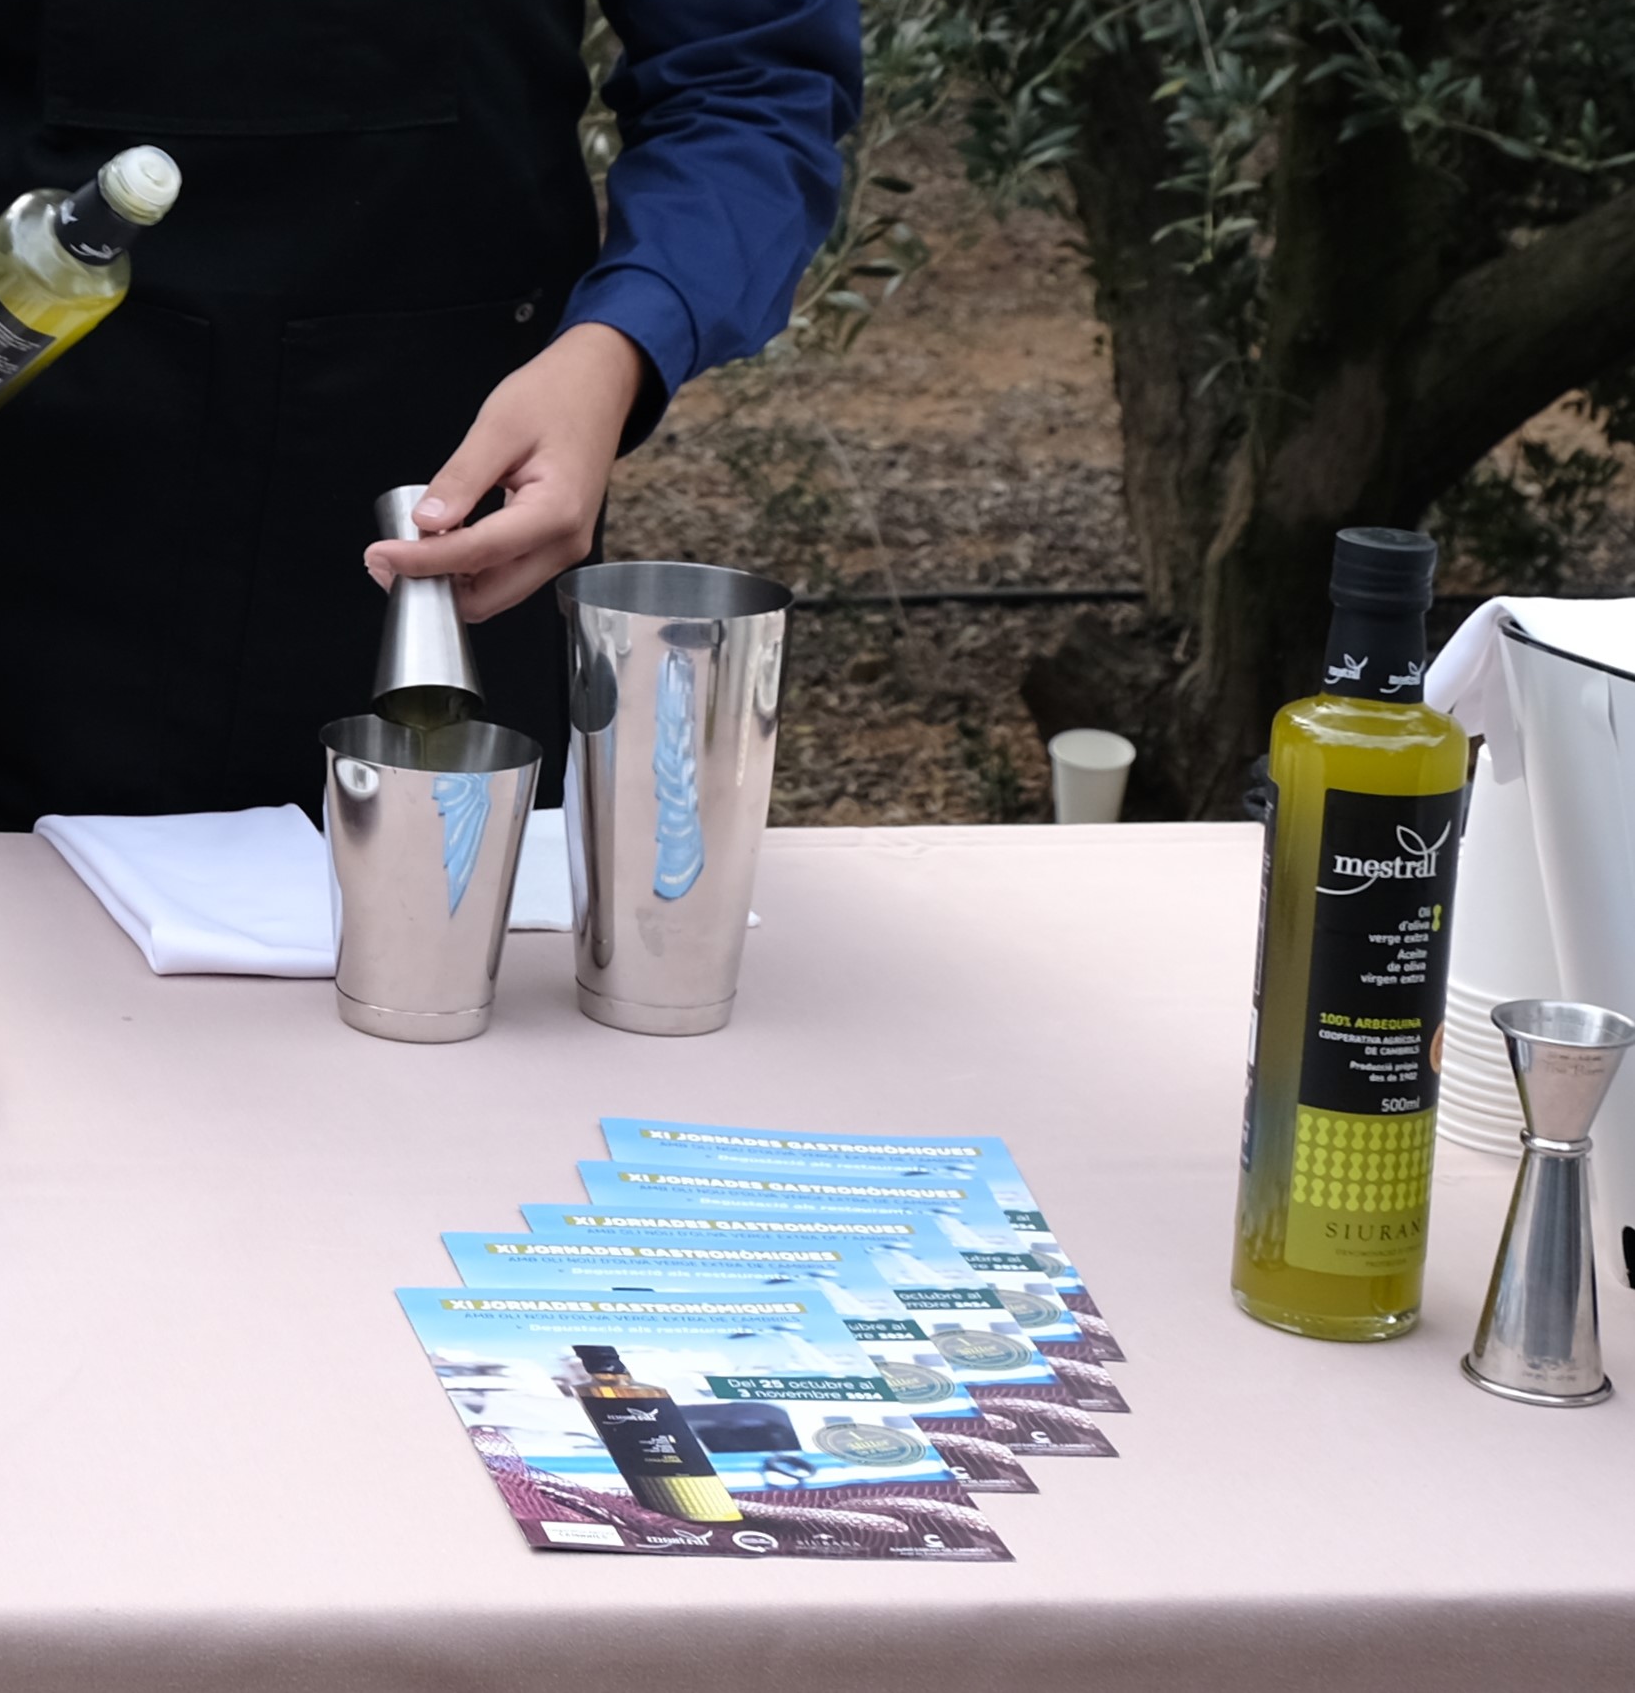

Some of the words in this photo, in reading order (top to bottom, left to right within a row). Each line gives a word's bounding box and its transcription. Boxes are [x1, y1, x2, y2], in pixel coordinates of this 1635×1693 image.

[1333, 851, 1437, 879] mestral
[1368, 934, 1401, 946] verge
[1404, 933, 1429, 944] extra
[1387, 961, 1401, 972] de
[1400, 974, 1426, 984] extra
[1319, 1012, 1351, 1027] 100%
[1355, 1017, 1422, 1030] ARBEQUINA
[1364, 1046, 1378, 1055] DE
[1381, 1096, 1421, 1113] 500ml
[649, 1129, 672, 1140] XI
[675, 1131, 782, 1148] JORNADES
[629, 1173, 650, 1183] XI
[655, 1175, 764, 1190] JORNADES
[573, 1216, 597, 1226] XI
[602, 1217, 712, 1229] JORNADES
[1325, 1218, 1422, 1242] SIURAN
[495, 1244, 519, 1254] XI
[524, 1244, 635, 1256] JORNADES
[449, 1299, 474, 1310] XI
[479, 1300, 595, 1312] JORNADES
[598, 1302, 801, 1315] GASTRONÒMIQUES
[727, 1379, 756, 1388] Del
[759, 1379, 784, 1389] 25
[789, 1380, 854, 1390] octubre
[859, 1381, 875, 1390] al
[737, 1389, 751, 1398] 3
[755, 1389, 841, 1399] novembre
